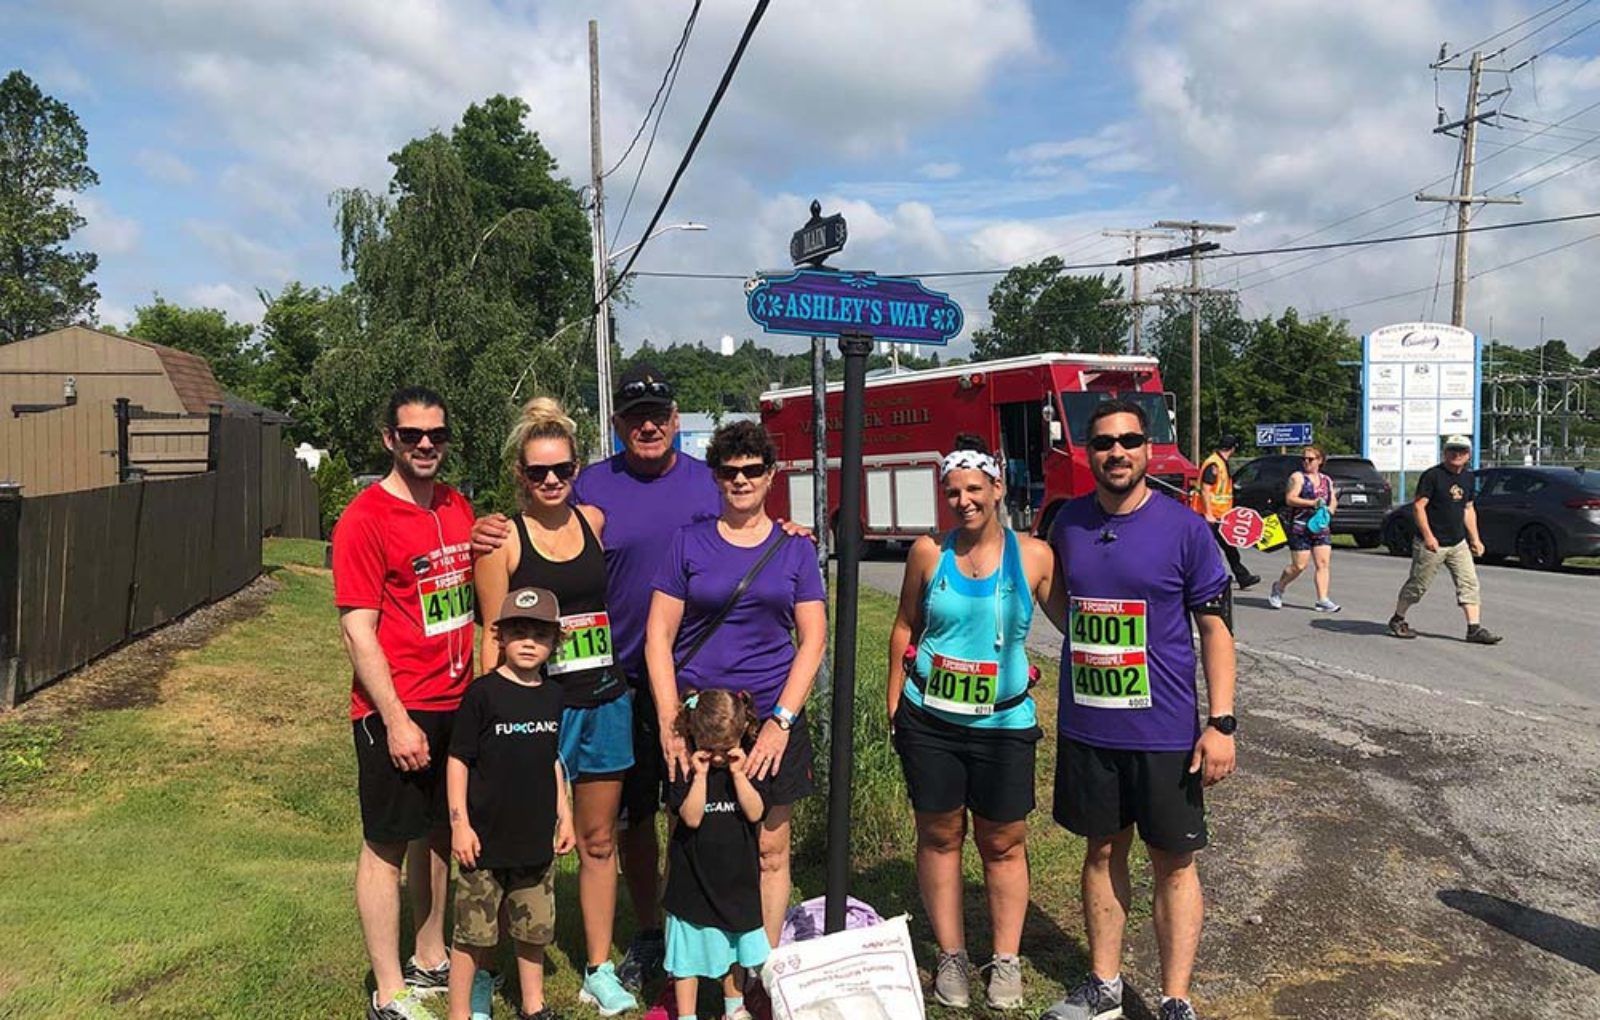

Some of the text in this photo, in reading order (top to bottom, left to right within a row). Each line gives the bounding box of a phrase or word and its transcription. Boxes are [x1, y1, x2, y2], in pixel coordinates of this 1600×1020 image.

[785, 293, 929, 328] ASHLEY'S WAY
[800, 408, 930, 433] VNKEK HILL
[1231, 509, 1254, 547] STOP
[1260, 517, 1279, 546] SLO
[428, 584, 473, 621] 4112
[558, 627, 607, 659] 113
[1075, 614, 1136, 645] 4001
[929, 669, 990, 704] 4015
[1076, 666, 1142, 697] 4002
